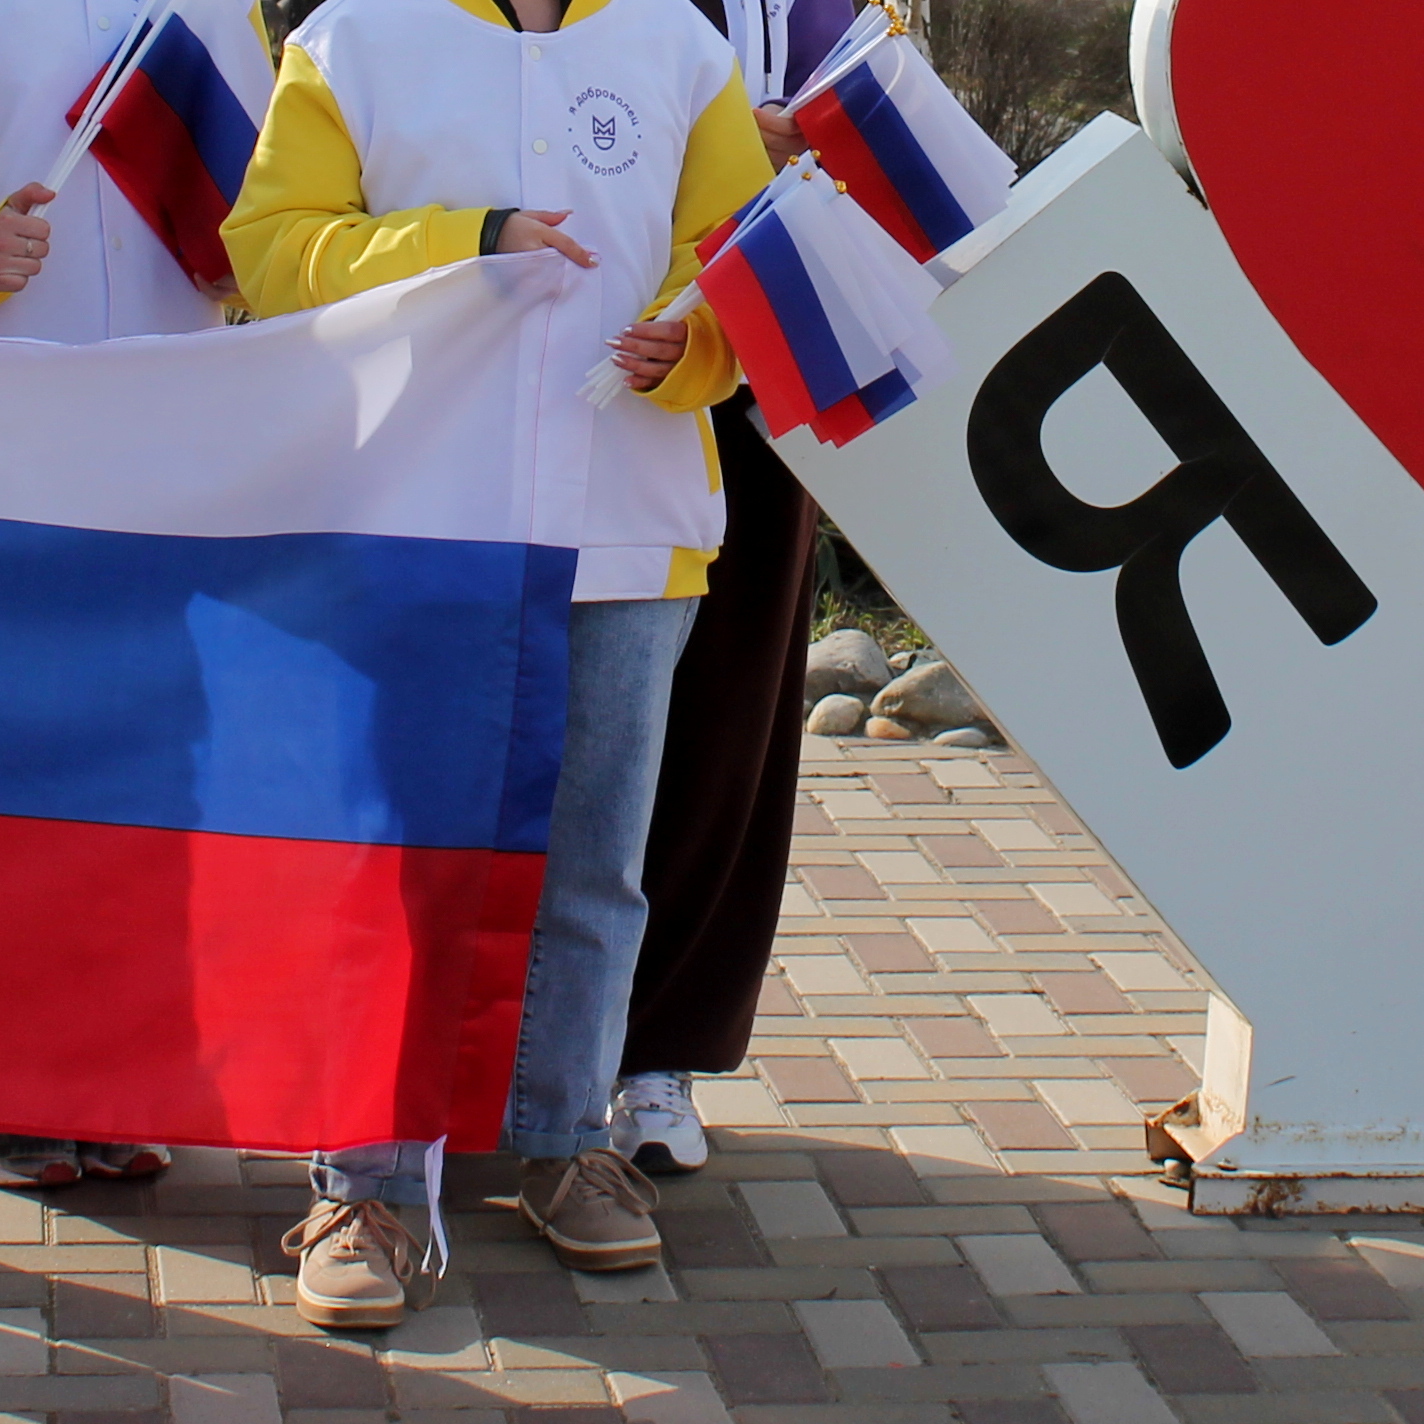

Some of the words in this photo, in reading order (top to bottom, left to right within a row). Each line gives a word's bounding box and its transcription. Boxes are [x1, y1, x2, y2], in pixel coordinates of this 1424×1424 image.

[575, 86, 640, 127] доброволец
[571, 143, 639, 177] ставрополья
[965, 270, 1379, 770] Я
